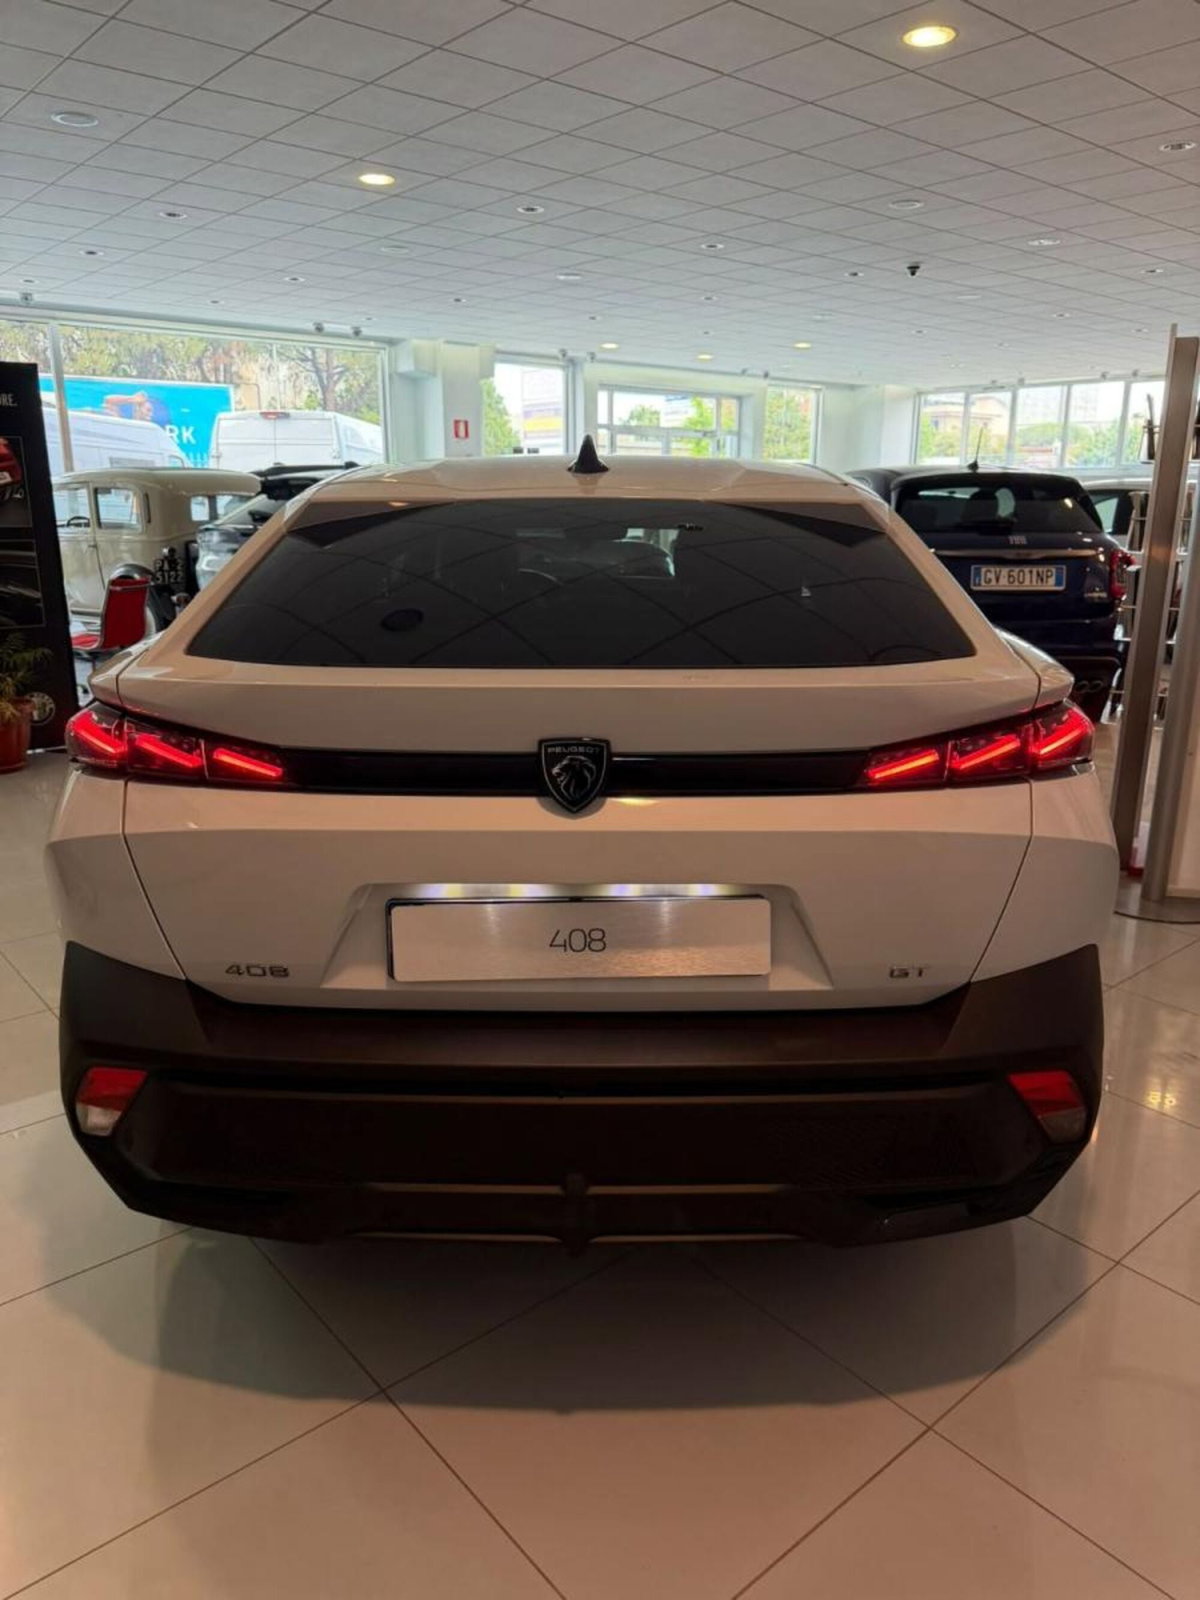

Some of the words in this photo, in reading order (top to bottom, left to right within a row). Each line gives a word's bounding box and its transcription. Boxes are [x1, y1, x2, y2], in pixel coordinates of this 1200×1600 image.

[547, 745, 600, 753] PEUGEOT
[548, 927, 606, 953] 408
[224, 963, 290, 978] 408
[889, 966, 930, 979] GT
